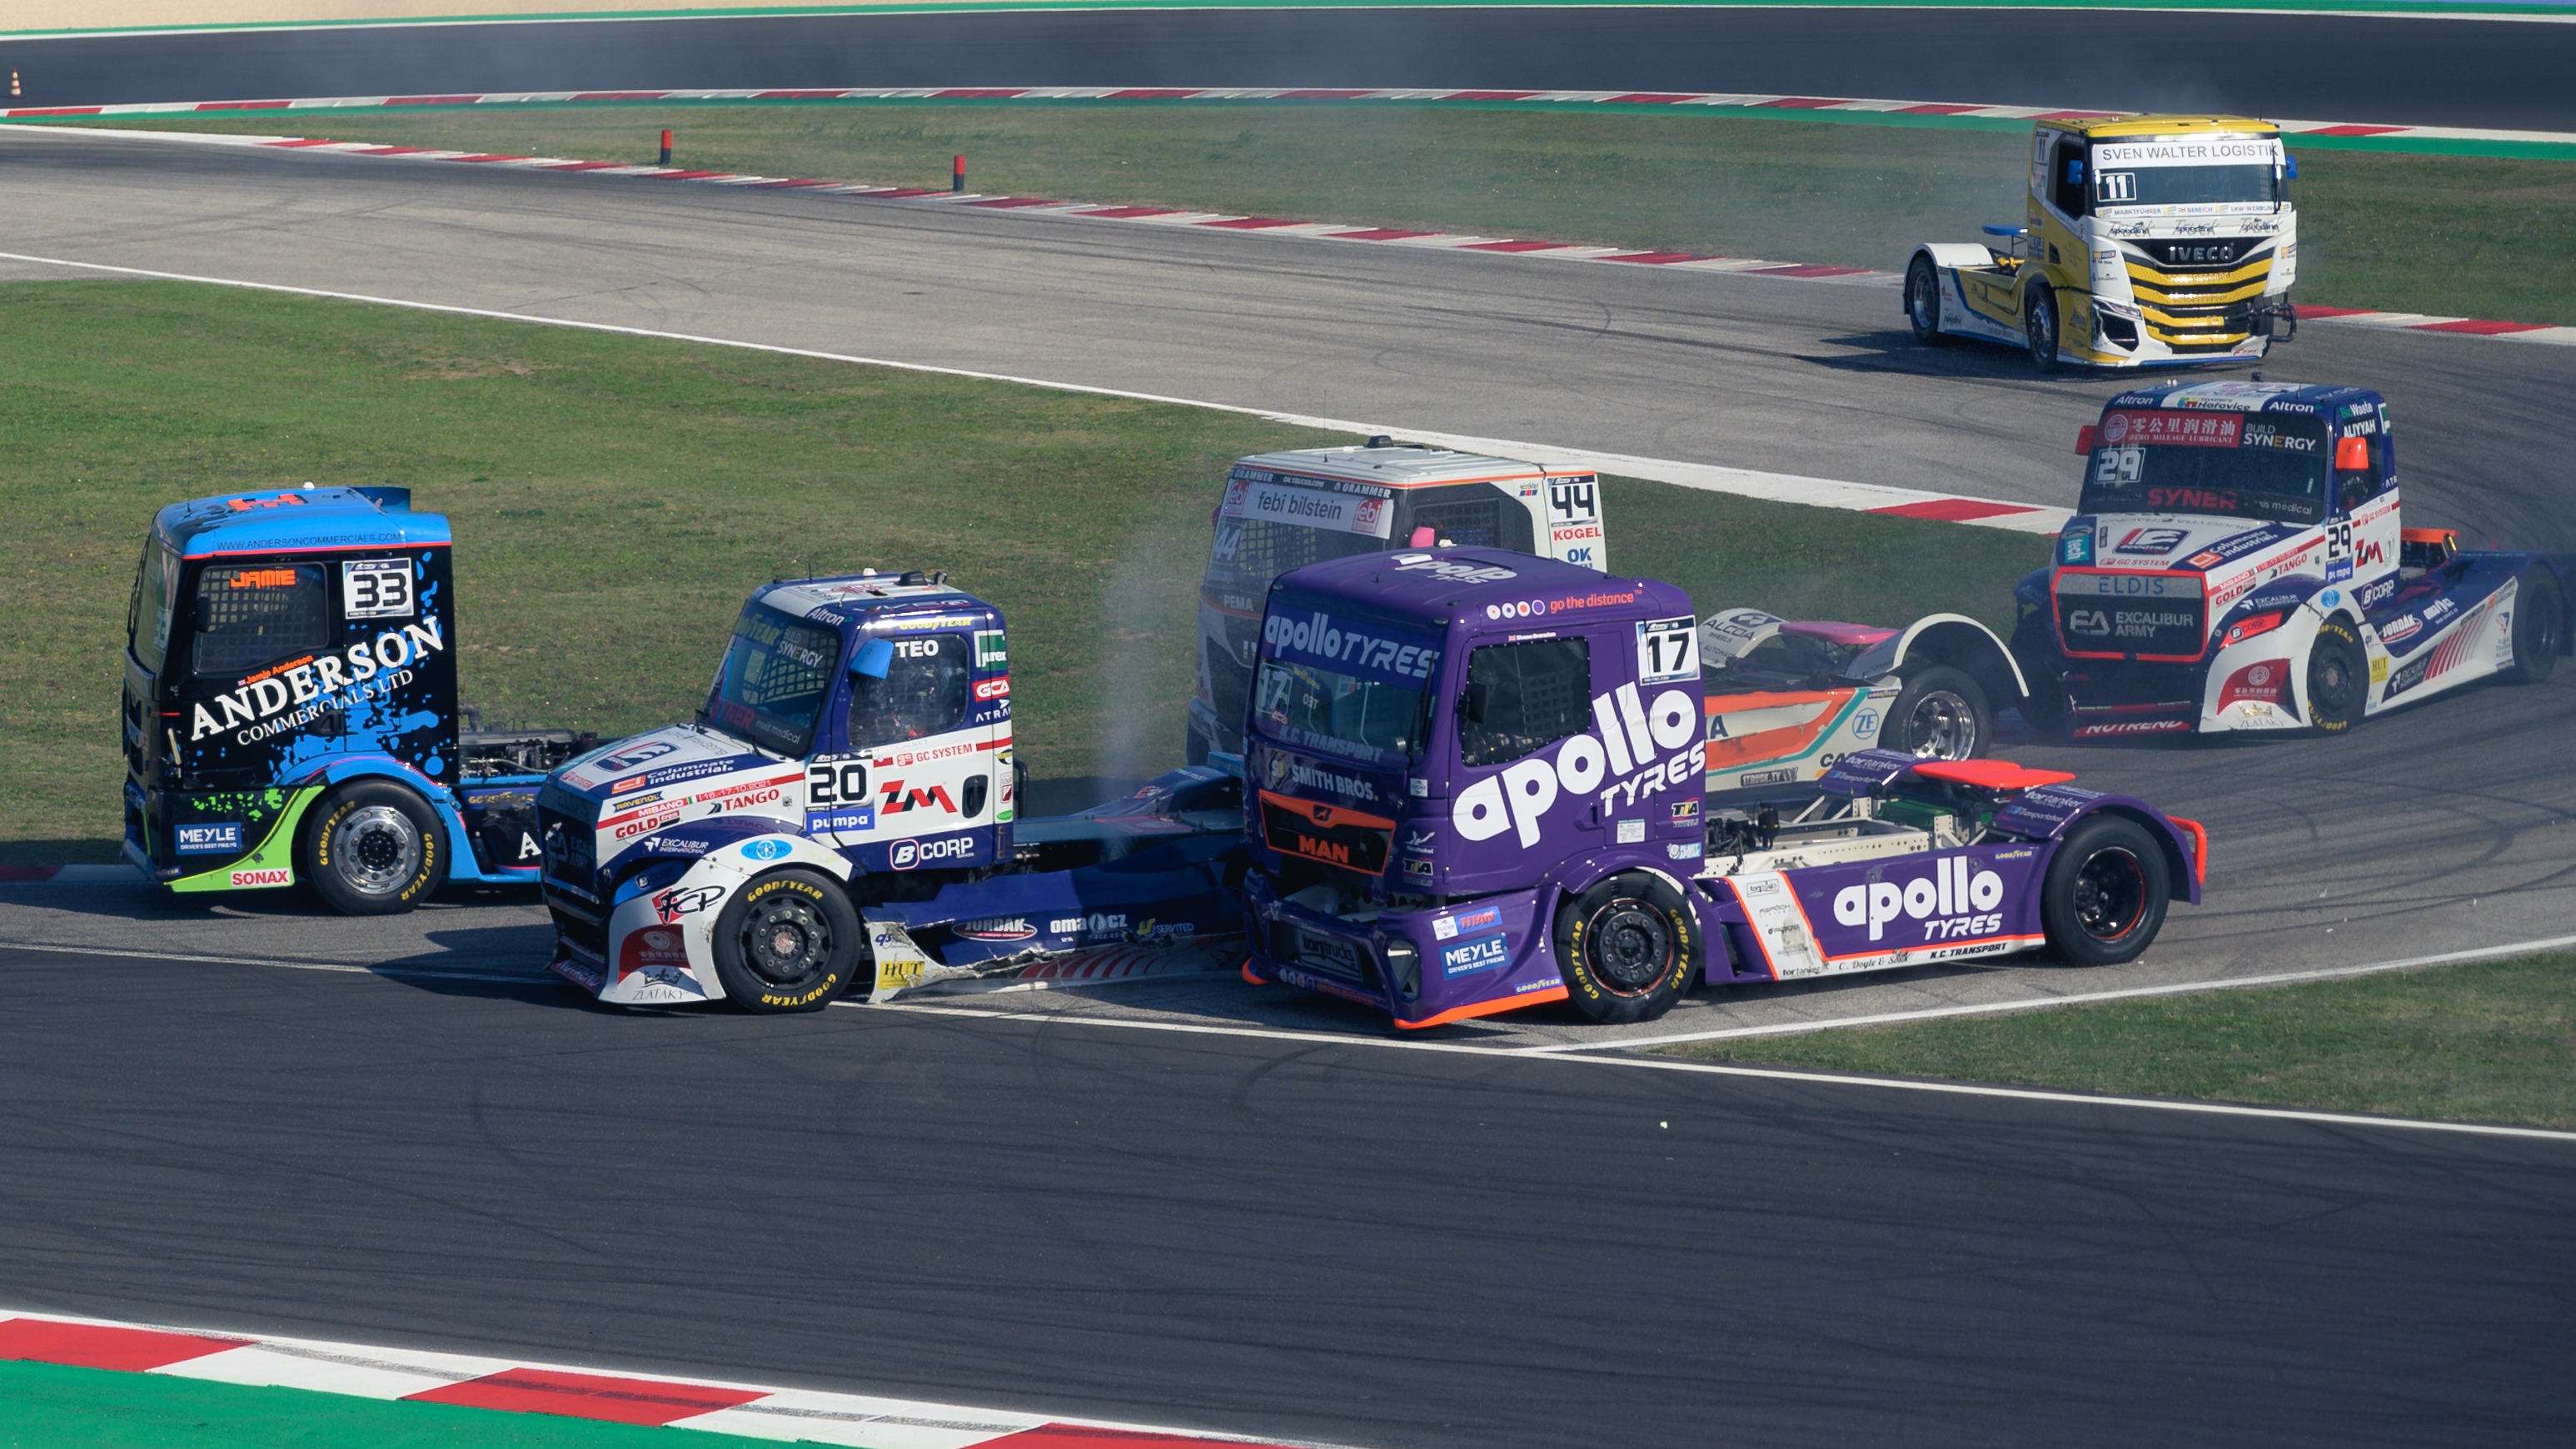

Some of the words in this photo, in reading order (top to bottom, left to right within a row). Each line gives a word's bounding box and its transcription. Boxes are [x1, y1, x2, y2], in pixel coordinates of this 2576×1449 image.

[2102, 147, 2143, 161] SVEN
[2146, 146, 2208, 159] WALTER
[2211, 144, 2279, 157] LOGISTIK
[2105, 175, 2128, 199] 11
[2170, 246, 2235, 261] IVECO
[2115, 396, 2155, 406] Altron
[2269, 401, 2314, 413] Altron
[2339, 401, 2374, 420] BioWaste
[2131, 416, 2237, 436] 零公里润滑油
[2245, 422, 2276, 435] BUILD
[2343, 418, 2377, 438] ALIYYAH
[2130, 433, 2150, 441] ZERO
[2152, 434, 2187, 442] MILEAGE
[2189, 435, 2234, 444] LUBRICANT
[2243, 432, 2317, 452] SYNERGY
[2096, 449, 2145, 482] 29
[1233, 470, 1274, 483] GRAMMER
[1342, 482, 1392, 499] GRAMMER
[1256, 490, 1285, 512] febi
[1288, 494, 1343, 520] bilstein
[1551, 484, 1596, 519] 44
[2271, 501, 2313, 515] medical
[216, 531, 402, 551] WWW.ANDERSONCOMMERCIALS.COM
[1553, 527, 1602, 541] KÖGEL
[2327, 524, 2352, 559] 29
[1567, 547, 1592, 563] OK
[2278, 553, 2308, 575] TANGO
[230, 569, 296, 588] JAMIE
[2098, 577, 2165, 595] ELDIS
[353, 571, 408, 609] 33
[2215, 585, 2244, 606] GOLD
[2373, 580, 2394, 601] CORP
[1223, 594, 1253, 612] PEMA
[1550, 600, 1566, 615] go
[1566, 595, 1586, 610] the
[806, 606, 845, 626] Altron
[898, 615, 973, 631] GOODYEAR
[2115, 610, 2194, 627] EXCALIBUR
[782, 628, 802, 644] BUILD
[1702, 619, 1755, 641] ALCOA
[1708, 631, 1732, 644] WHEELS
[2115, 624, 2156, 638] ARMY
[776, 640, 824, 668] SYNERGY
[894, 640, 939, 659] TEO
[1264, 611, 1343, 659] apollo
[1341, 631, 1441, 679] TYRES
[1647, 631, 1690, 674] 17
[246, 670, 272, 685] Jamie
[272, 655, 314, 676] Anderson
[2372, 656, 2388, 671] HUT
[191, 615, 444, 741] ANDERSON
[1260, 667, 1290, 710] 17
[237, 685, 375, 746] COMMERCIALS
[378, 669, 414, 695] LTD
[1856, 715, 1875, 734] ZF
[916, 751, 930, 763] GC
[931, 743, 973, 759] SYSTEM
[1303, 729, 1384, 763] TRANSPORT
[650, 764, 735, 785] industrial.
[1452, 680, 1697, 850] apollo
[810, 764, 868, 804] 20
[1291, 764, 1335, 792] SMITH
[1600, 739, 1707, 819] TYRES
[615, 794, 660, 810] RAVENOL
[722, 789, 780, 811] TANGO
[879, 779, 959, 816] ZM
[637, 799, 685, 818] MISANO
[1671, 799, 1700, 818] TIA
[319, 799, 356, 866] GOODYEAR
[615, 816, 659, 839] GOLD
[812, 814, 869, 831] pumpa
[179, 827, 237, 844] MEYLE
[661, 838, 710, 850] EXCALIBUR
[659, 844, 705, 854] INTERNATIONAL
[919, 836, 974, 860] CORP
[1298, 834, 1350, 864] MAN
[401, 833, 435, 900] GOODYEAR
[1403, 858, 1434, 877] TIA
[232, 870, 289, 886] SONAX
[747, 879, 824, 903] GOODYEAR
[1833, 854, 2005, 942] apollo
[1049, 918, 1088, 934] oma
[1107, 914, 1129, 929] cz
[1460, 910, 1496, 929] TITAN
[1924, 913, 2004, 941] TYRES
[1445, 939, 1503, 967] MEYLE
[1669, 908, 1692, 990] GOODYEAR
[1929, 949, 1947, 959] K.C.
[1949, 942, 2008, 958] TRANSPORT
[1472, 960, 1486, 969] BEST
[1571, 920, 1600, 1000] GOODYEAR
[1851, 959, 1876, 970] Doyle
[1878, 958, 1886, 967] &
[884, 963, 924, 980] HUT
[761, 973, 837, 1006] GOODYEAR
[1516, 978, 1561, 993] GOODYEAR
